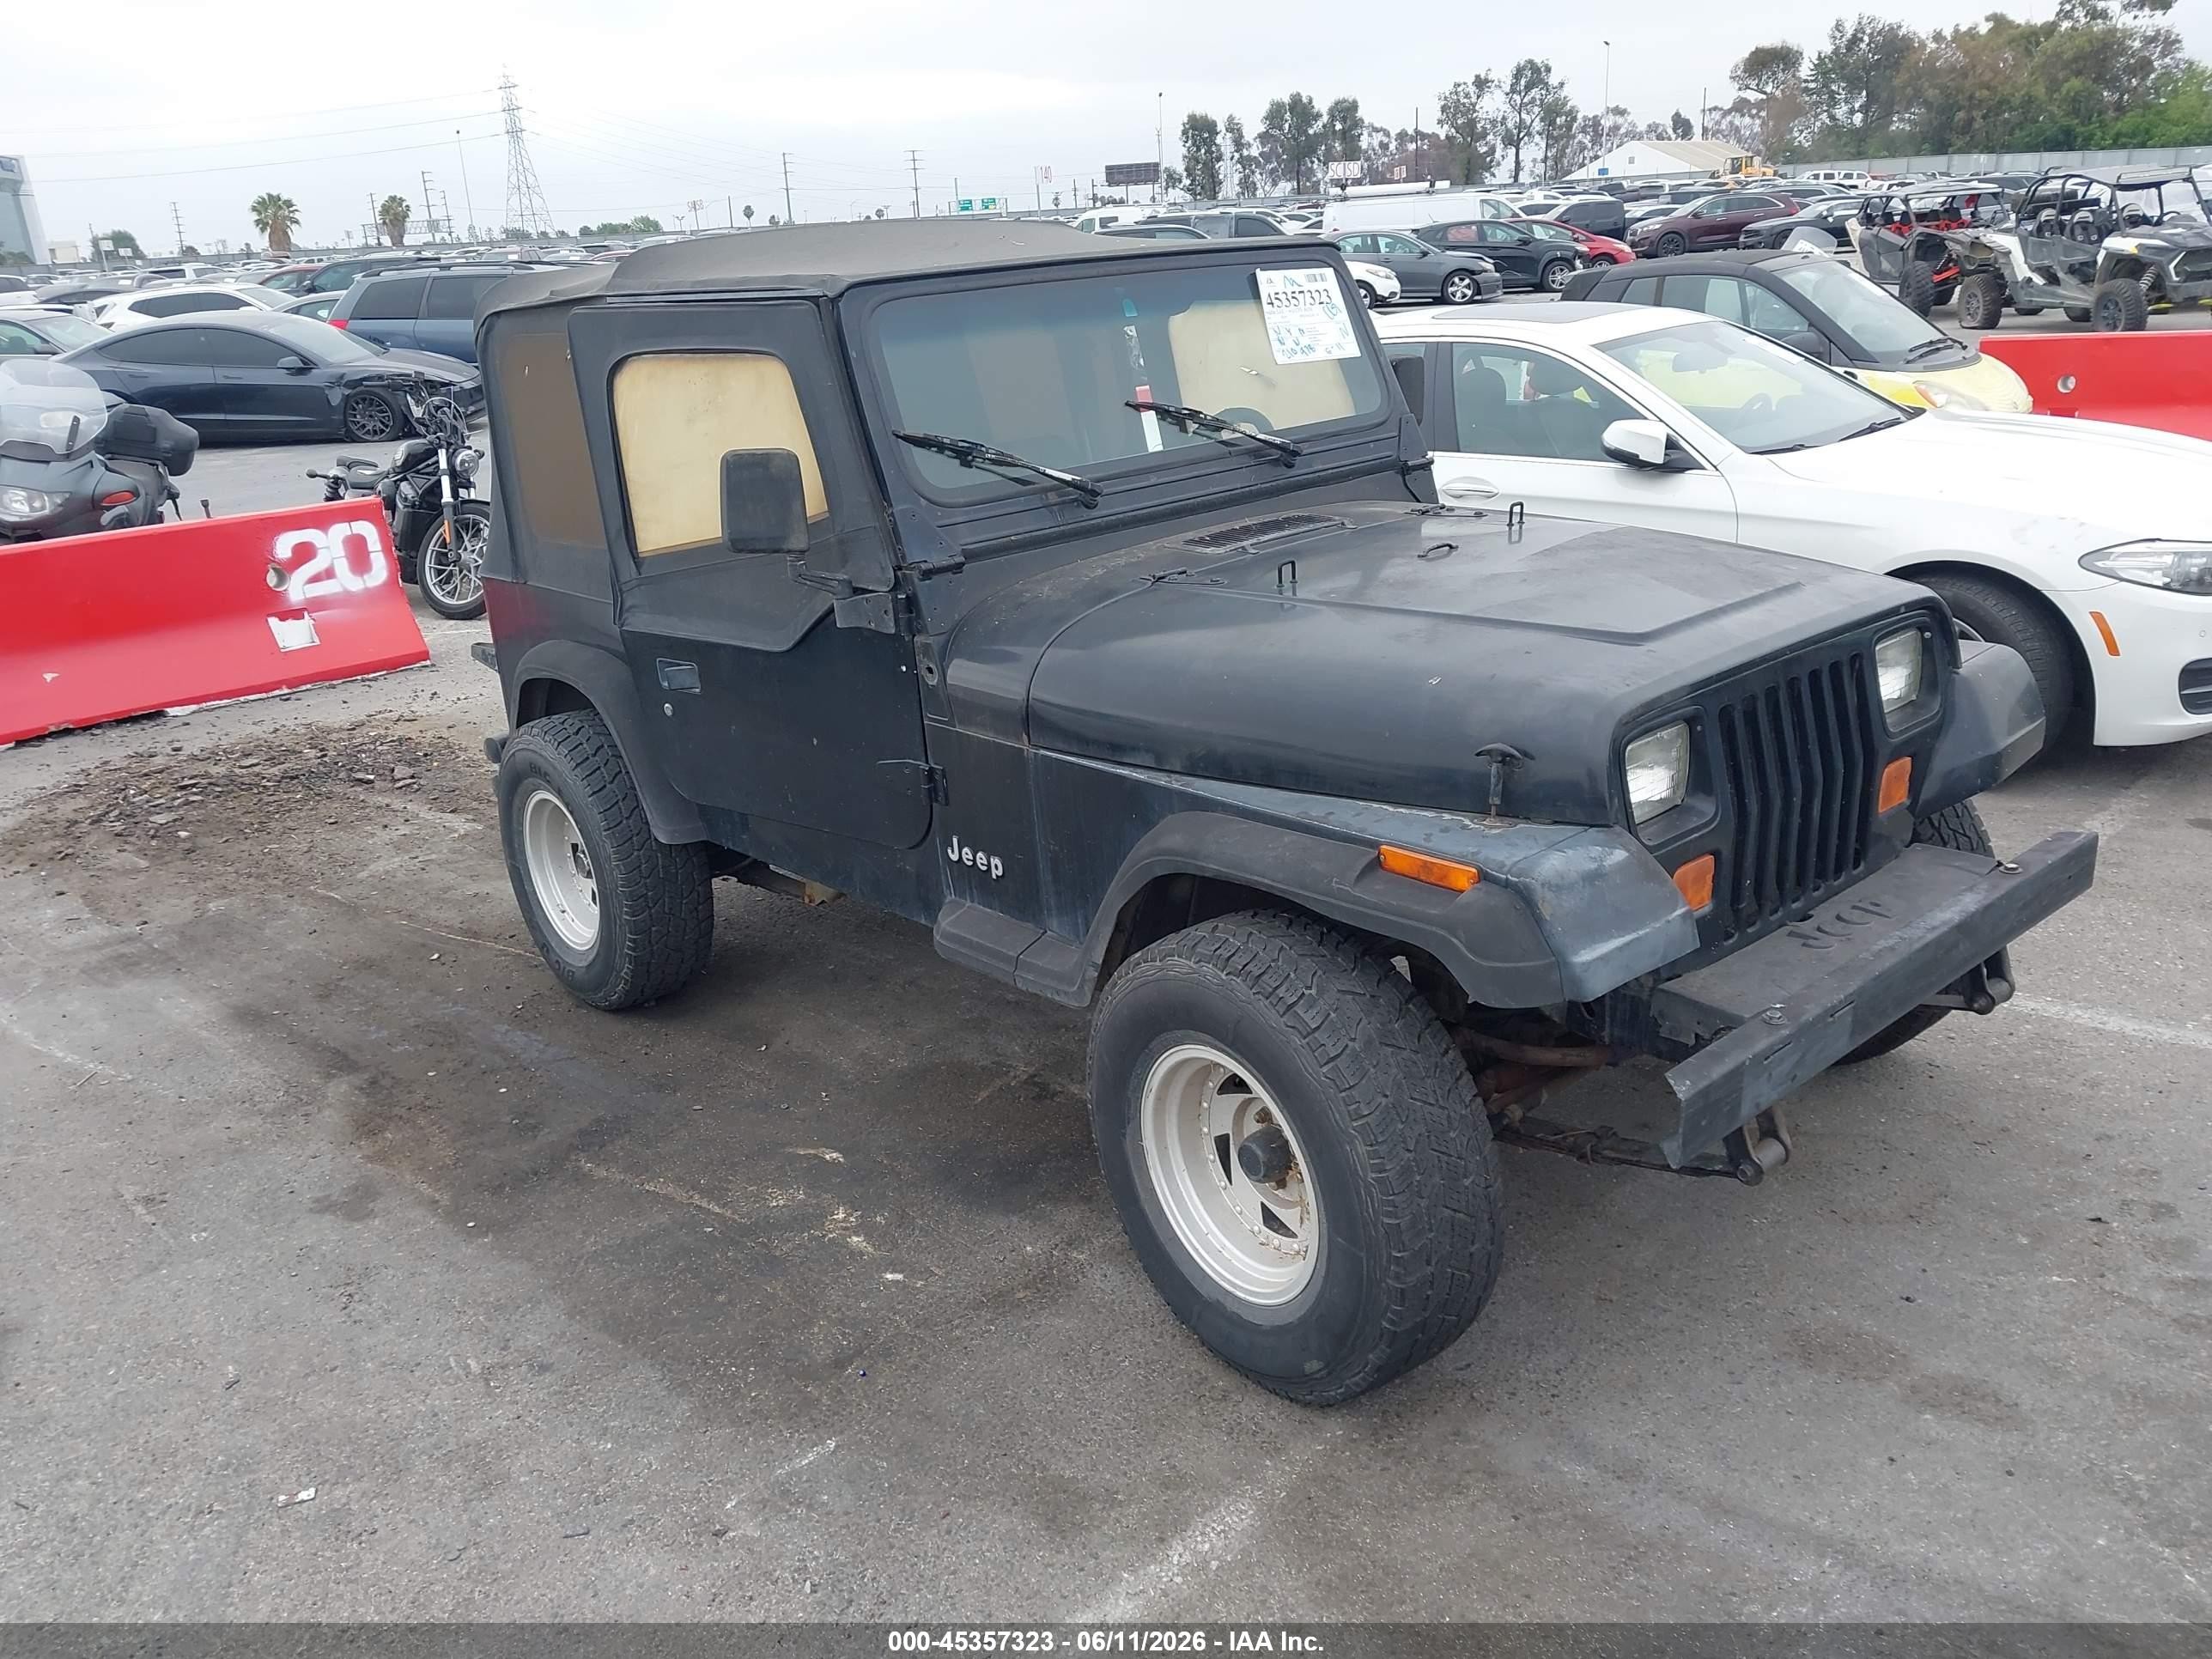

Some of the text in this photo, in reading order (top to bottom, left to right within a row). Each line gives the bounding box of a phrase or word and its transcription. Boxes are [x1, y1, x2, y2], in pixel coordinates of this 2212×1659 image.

[1347, 161, 1359, 177] SD
[1267, 289, 1333, 308] 45357323
[273, 520, 388, 603] 20
[946, 835, 1004, 880] Jeep
